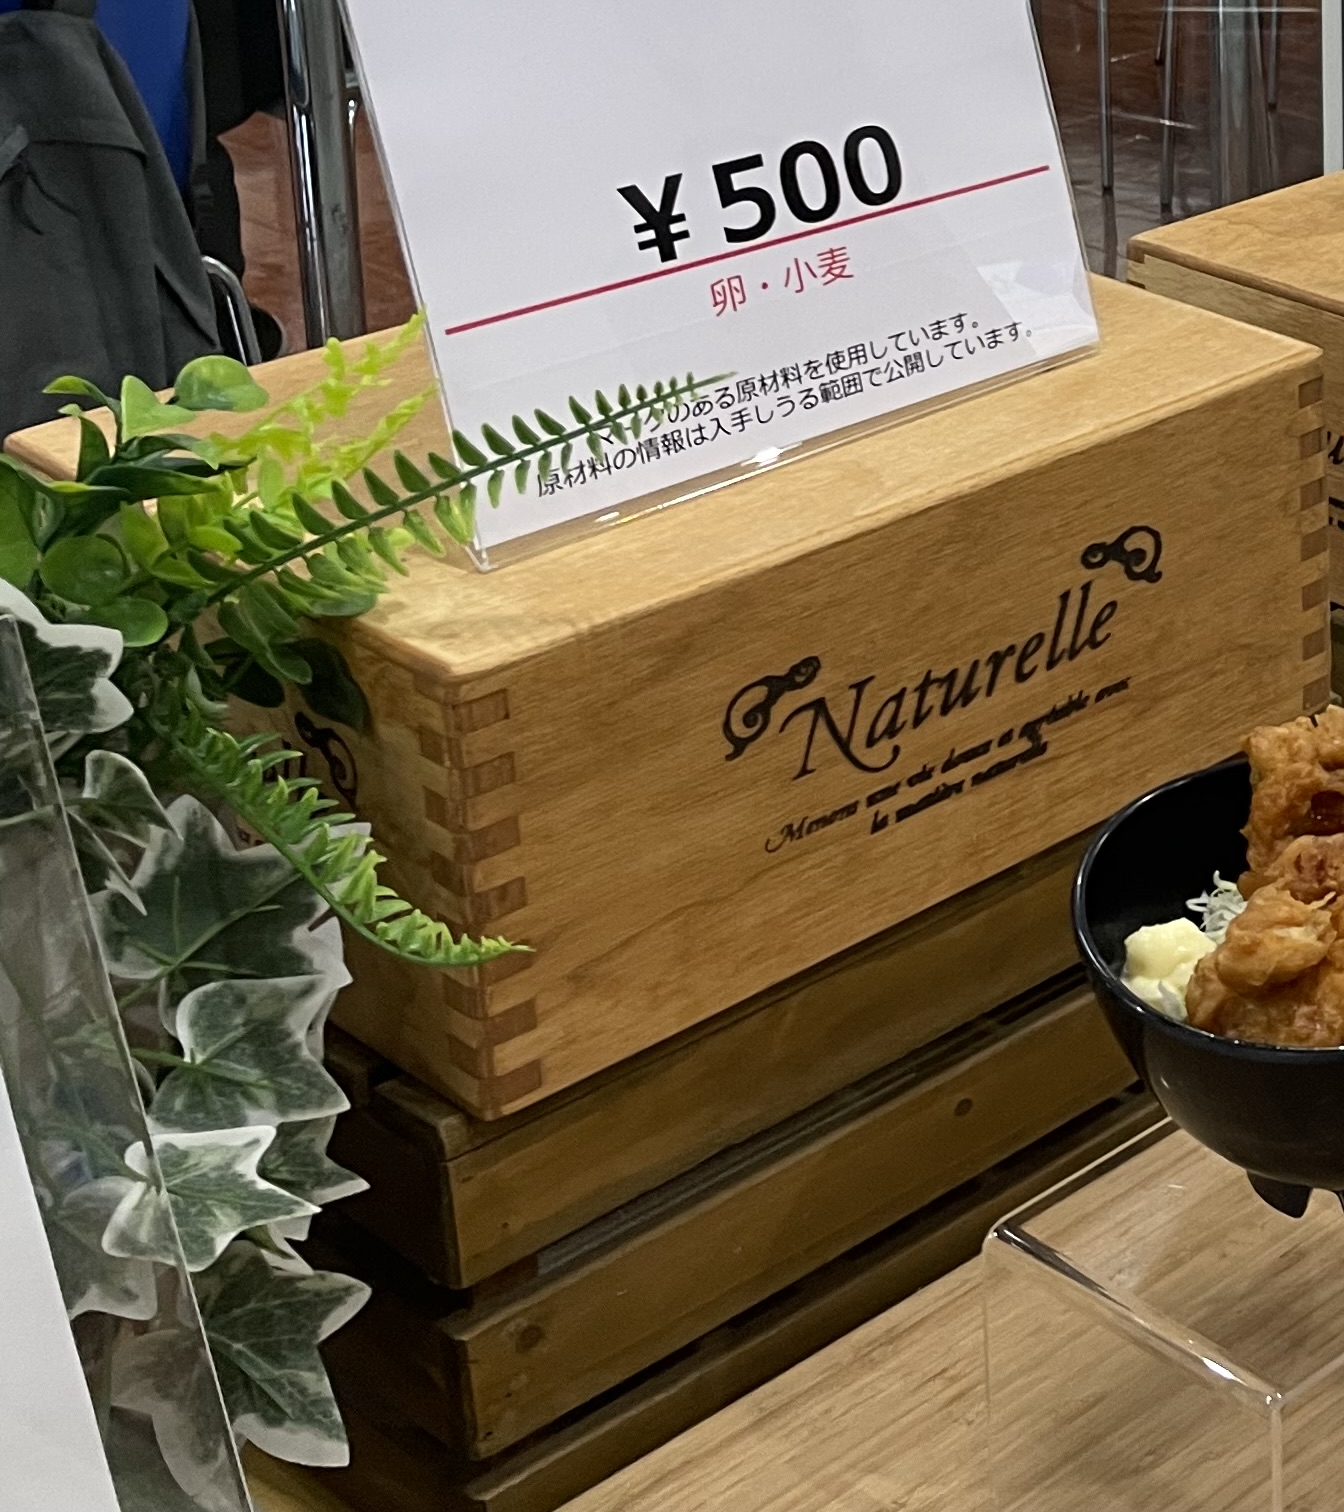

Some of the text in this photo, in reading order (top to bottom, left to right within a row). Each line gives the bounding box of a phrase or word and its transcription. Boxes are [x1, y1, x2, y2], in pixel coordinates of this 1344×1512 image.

[617, 125, 903, 263] ¥500
[710, 246, 855, 317] 卵・小麦
[536, 320, 1033, 498] 原材料の情報は入手しうる範囲で公開しています。
[778, 578, 1119, 782] Naturelle
